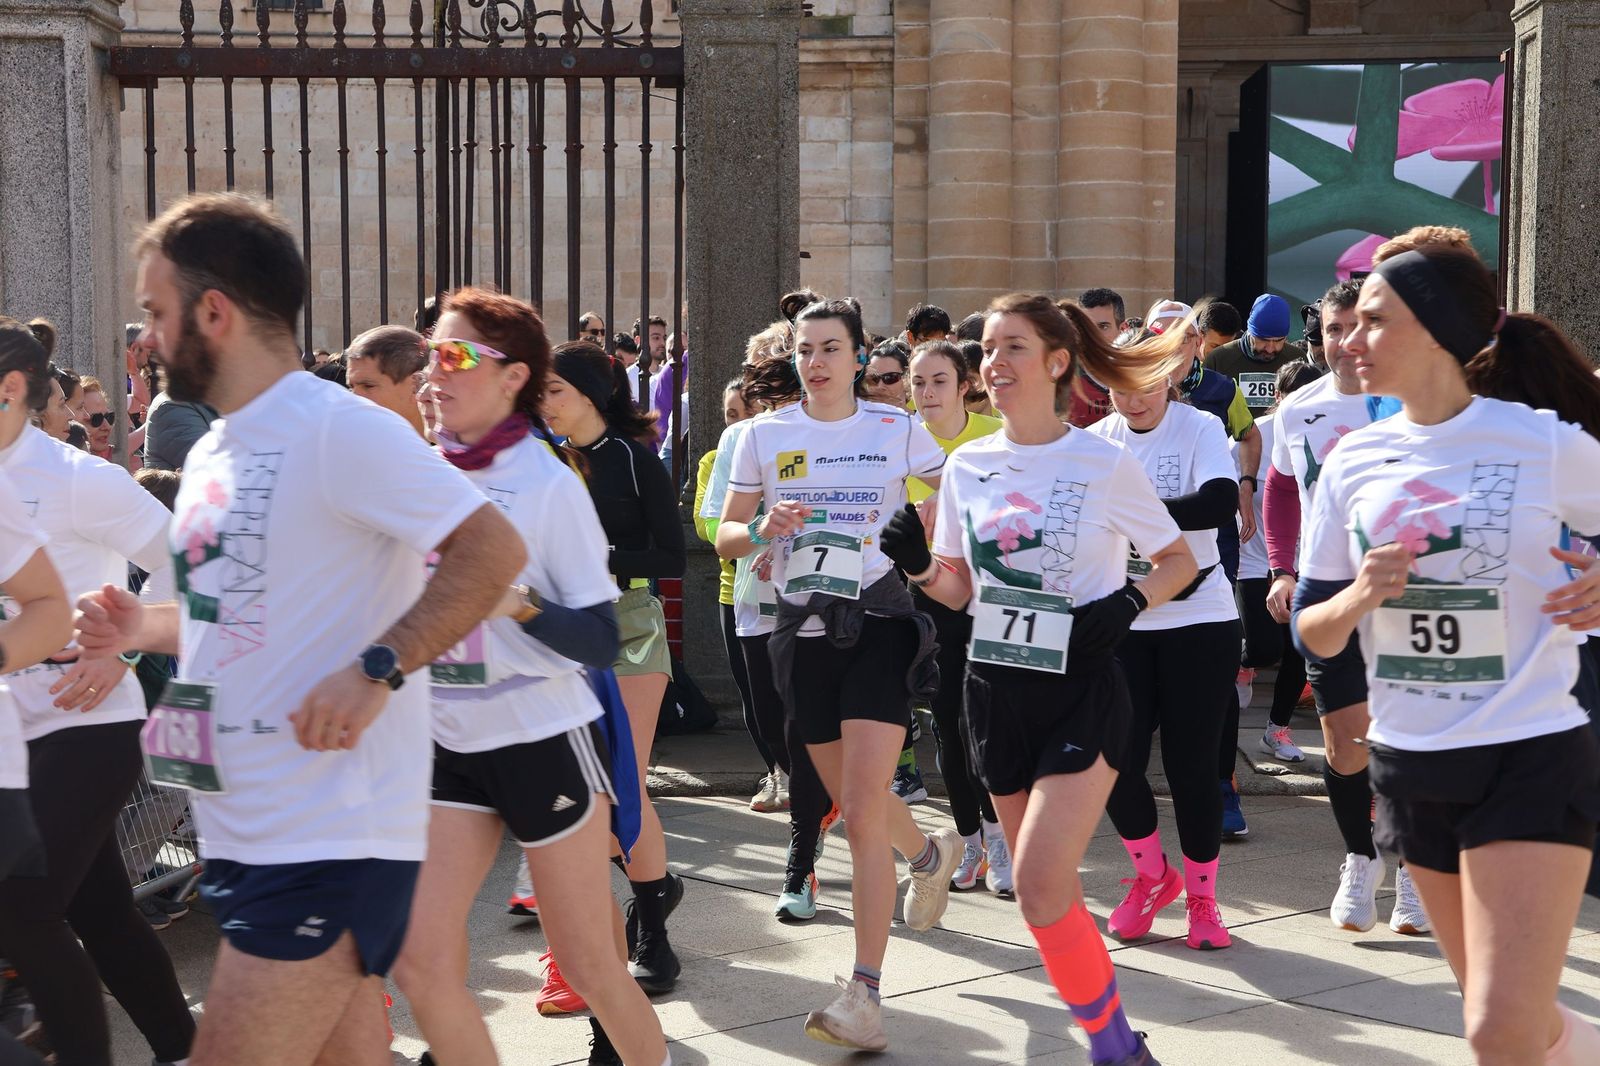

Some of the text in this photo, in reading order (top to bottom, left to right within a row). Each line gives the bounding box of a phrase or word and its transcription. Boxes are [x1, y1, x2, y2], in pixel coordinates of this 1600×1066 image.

[1248, 382, 1275, 397] 269
[858, 453, 887, 462] Peña
[837, 491, 879, 503] DUERO
[829, 511, 866, 522] VALDÉS
[813, 547, 829, 571] 7
[1002, 608, 1037, 643] 71
[1410, 613, 1461, 655] 59
